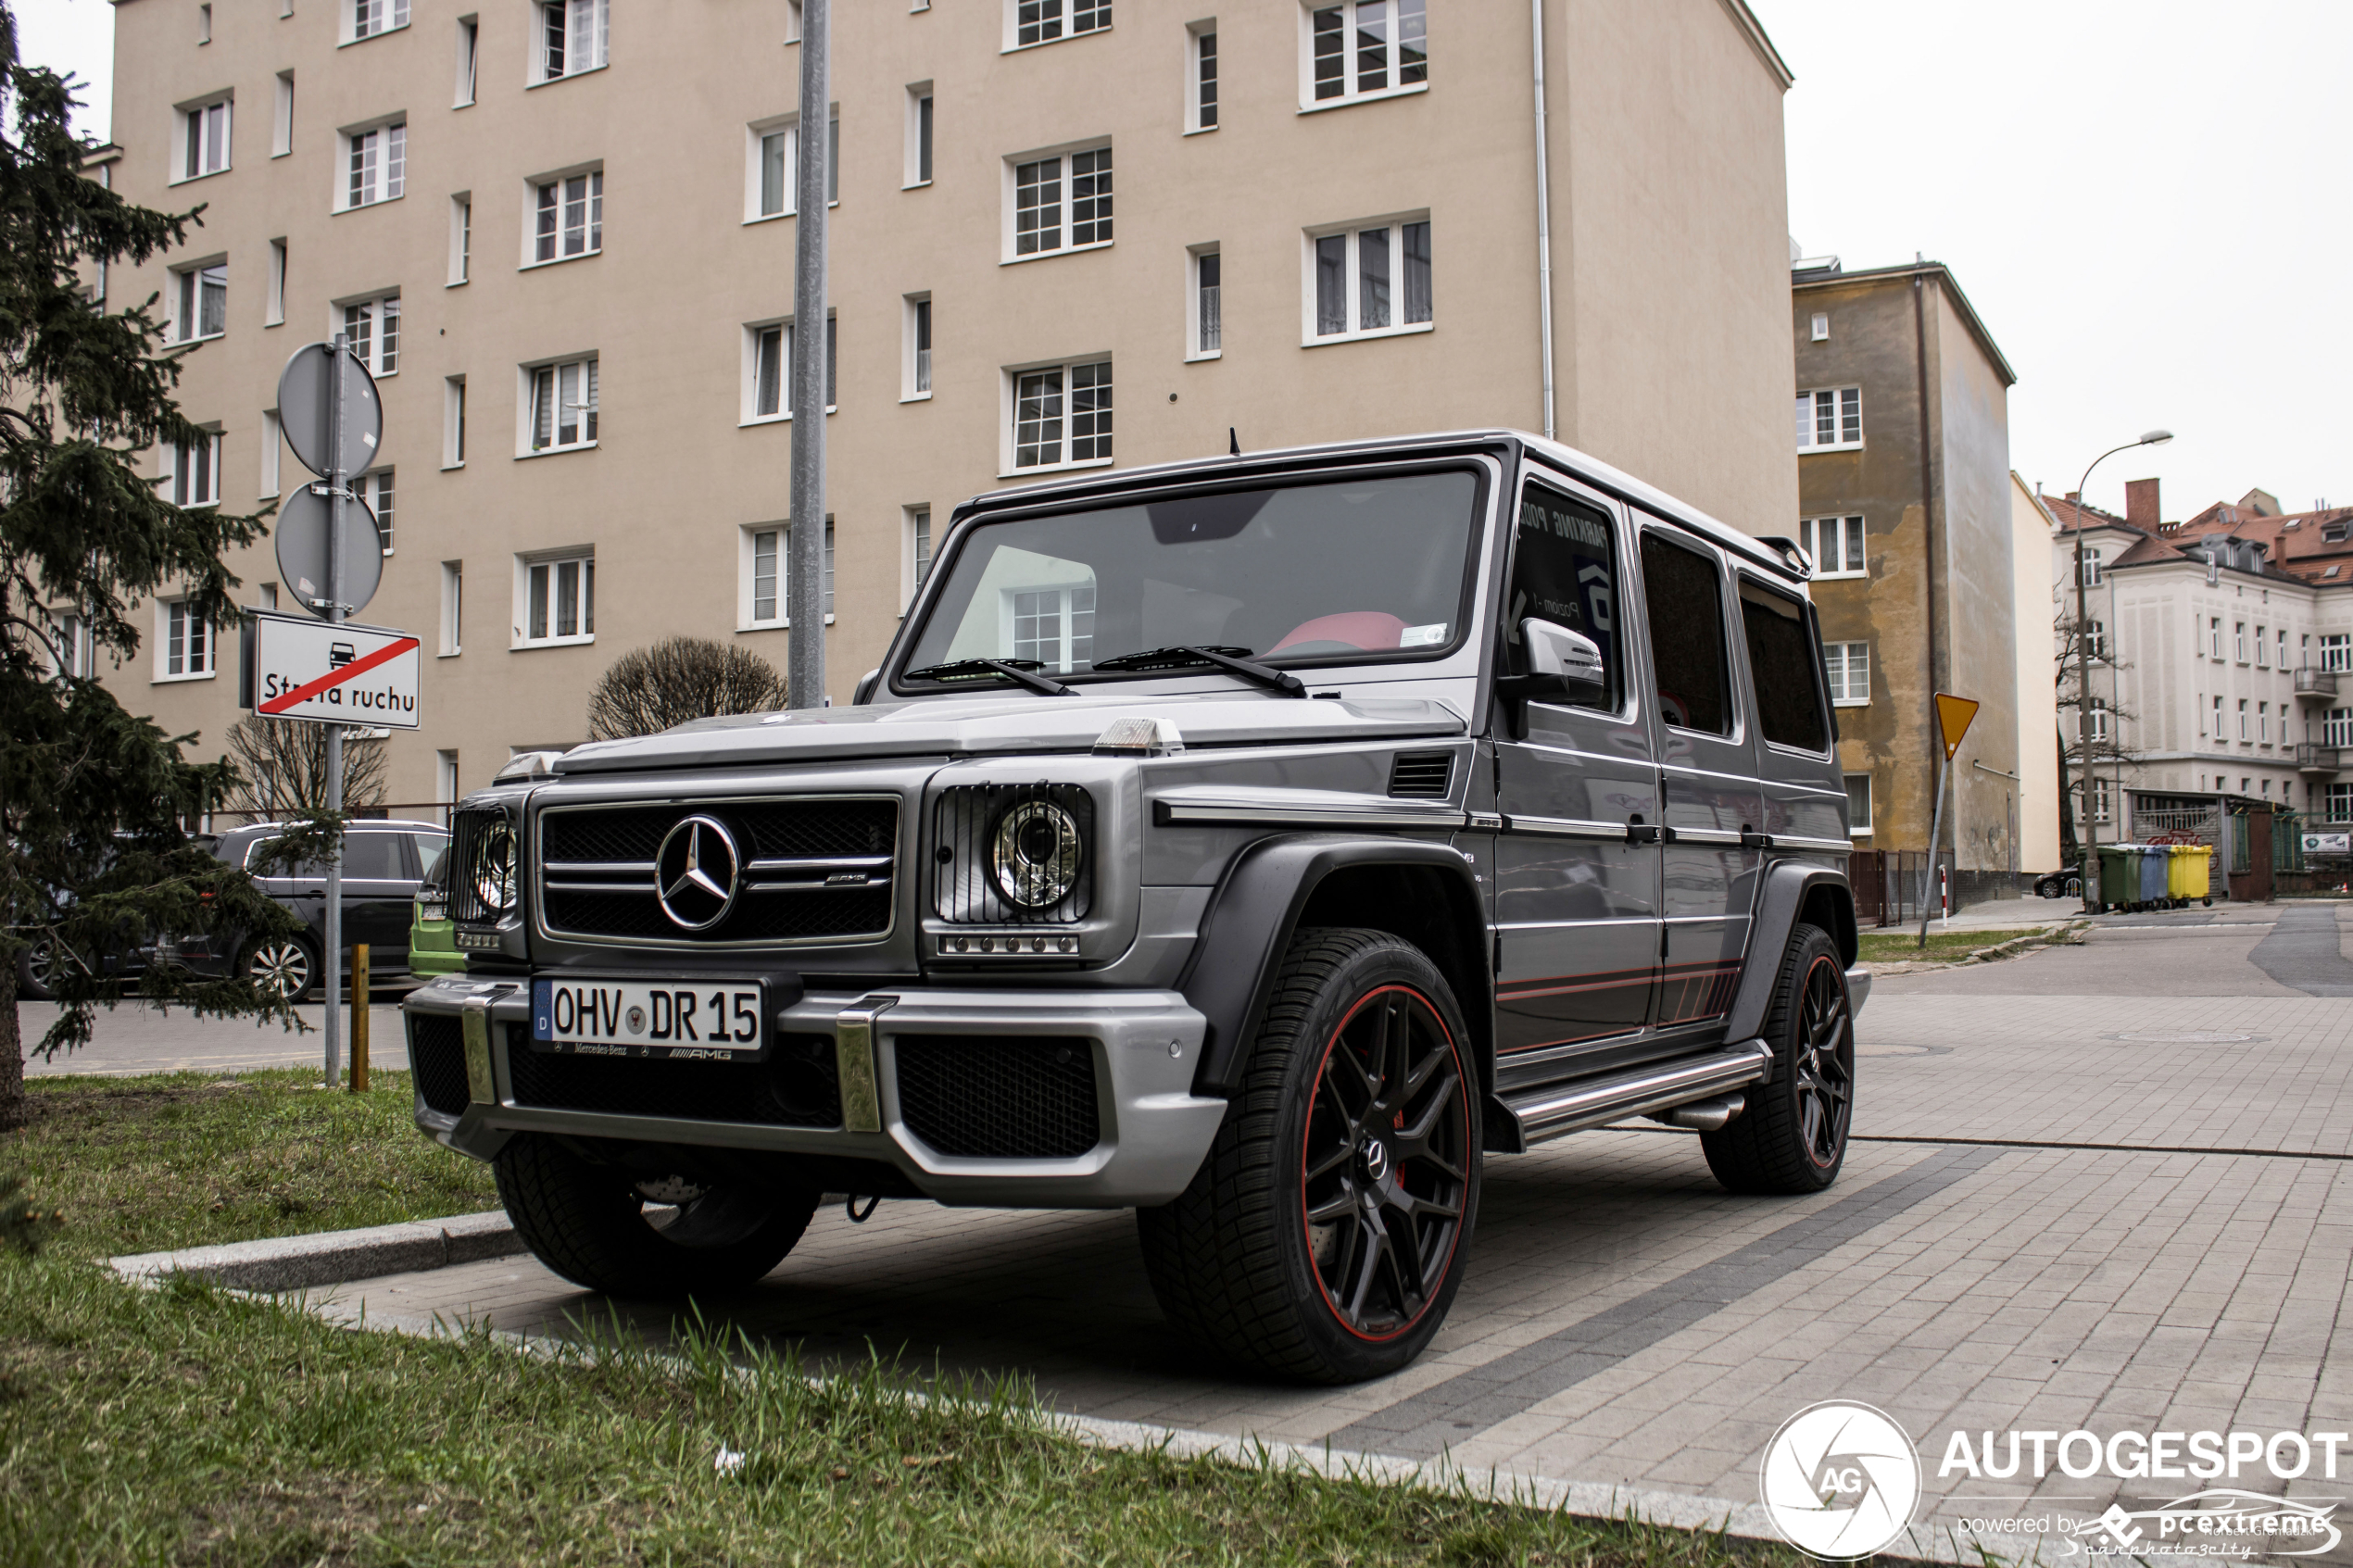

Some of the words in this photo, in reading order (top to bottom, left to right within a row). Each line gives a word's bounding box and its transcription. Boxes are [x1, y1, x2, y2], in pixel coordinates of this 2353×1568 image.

[265, 673, 342, 705] Sta
[352, 686, 414, 712] ruchu
[539, 1017, 547, 1031] D
[554, 987, 623, 1037] OHV
[649, 990, 698, 1041] DR
[709, 992, 758, 1043] 15
[574, 1042, 627, 1056] Mercedes-Benz
